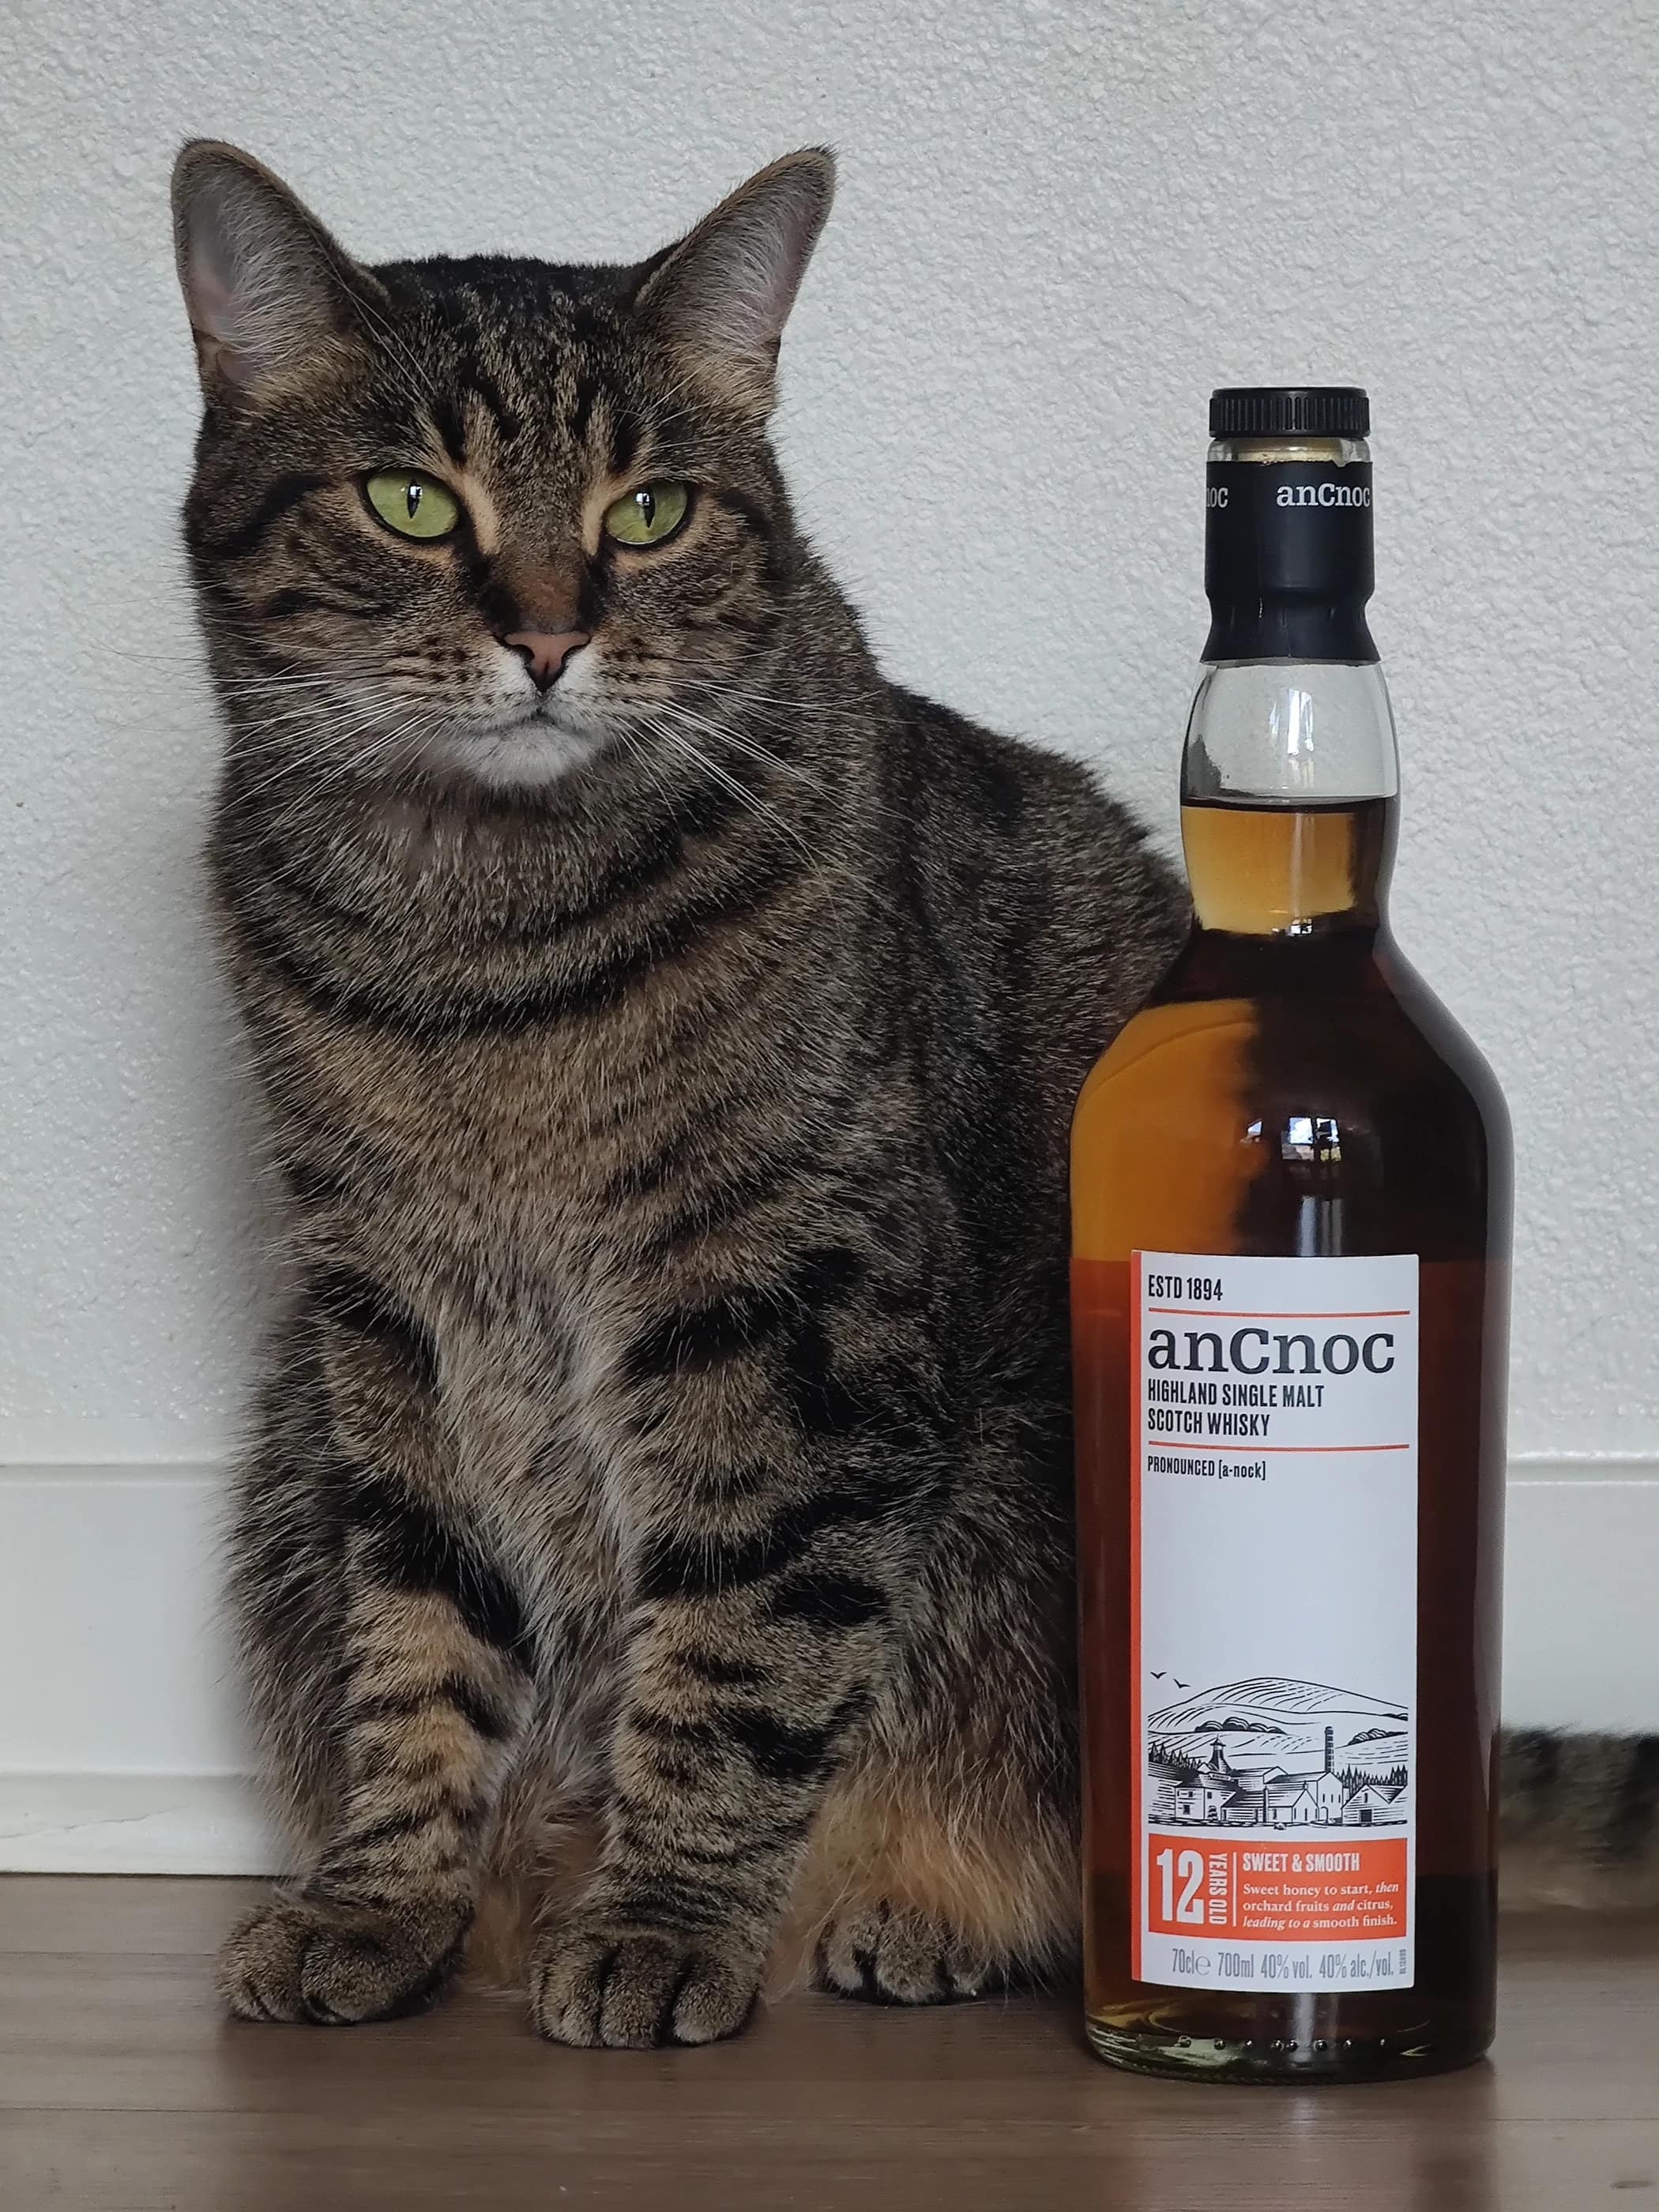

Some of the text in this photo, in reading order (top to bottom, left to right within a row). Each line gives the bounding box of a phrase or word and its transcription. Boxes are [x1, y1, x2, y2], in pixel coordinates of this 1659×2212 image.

[1277, 483, 1370, 507] anCnoc
[1148, 1274, 1223, 1300] ESTD 1894
[1148, 1327, 1394, 1375] anCnoc
[1148, 1379, 1325, 1408] HIGHLAND SINGLE MALT
[1148, 1408, 1270, 1436] SCOTCH WHISKY
[1147, 1455, 1266, 1480] PRONOUNCED [a-nock]
[1243, 1853, 1360, 1872] SWEET & SMOOTH
[1157, 1849, 1204, 1924] 12
[1209, 1853, 1228, 1924] YEARS OLD
[1243, 1881, 1399, 1898] Sweet honey to start, then
[1243, 1899, 1394, 1912] orchard fruits and citrus,
[1243, 1914, 1398, 1931] leading to a smooth finish.
[1217, 1951, 1254, 1977] 700ml
[1260, 1953, 1288, 1979] 40%
[1292, 1954, 1312, 1979] vol.
[1319, 1953, 1347, 1979] 40%
[1350, 1950, 1394, 1979] alc./vol.
